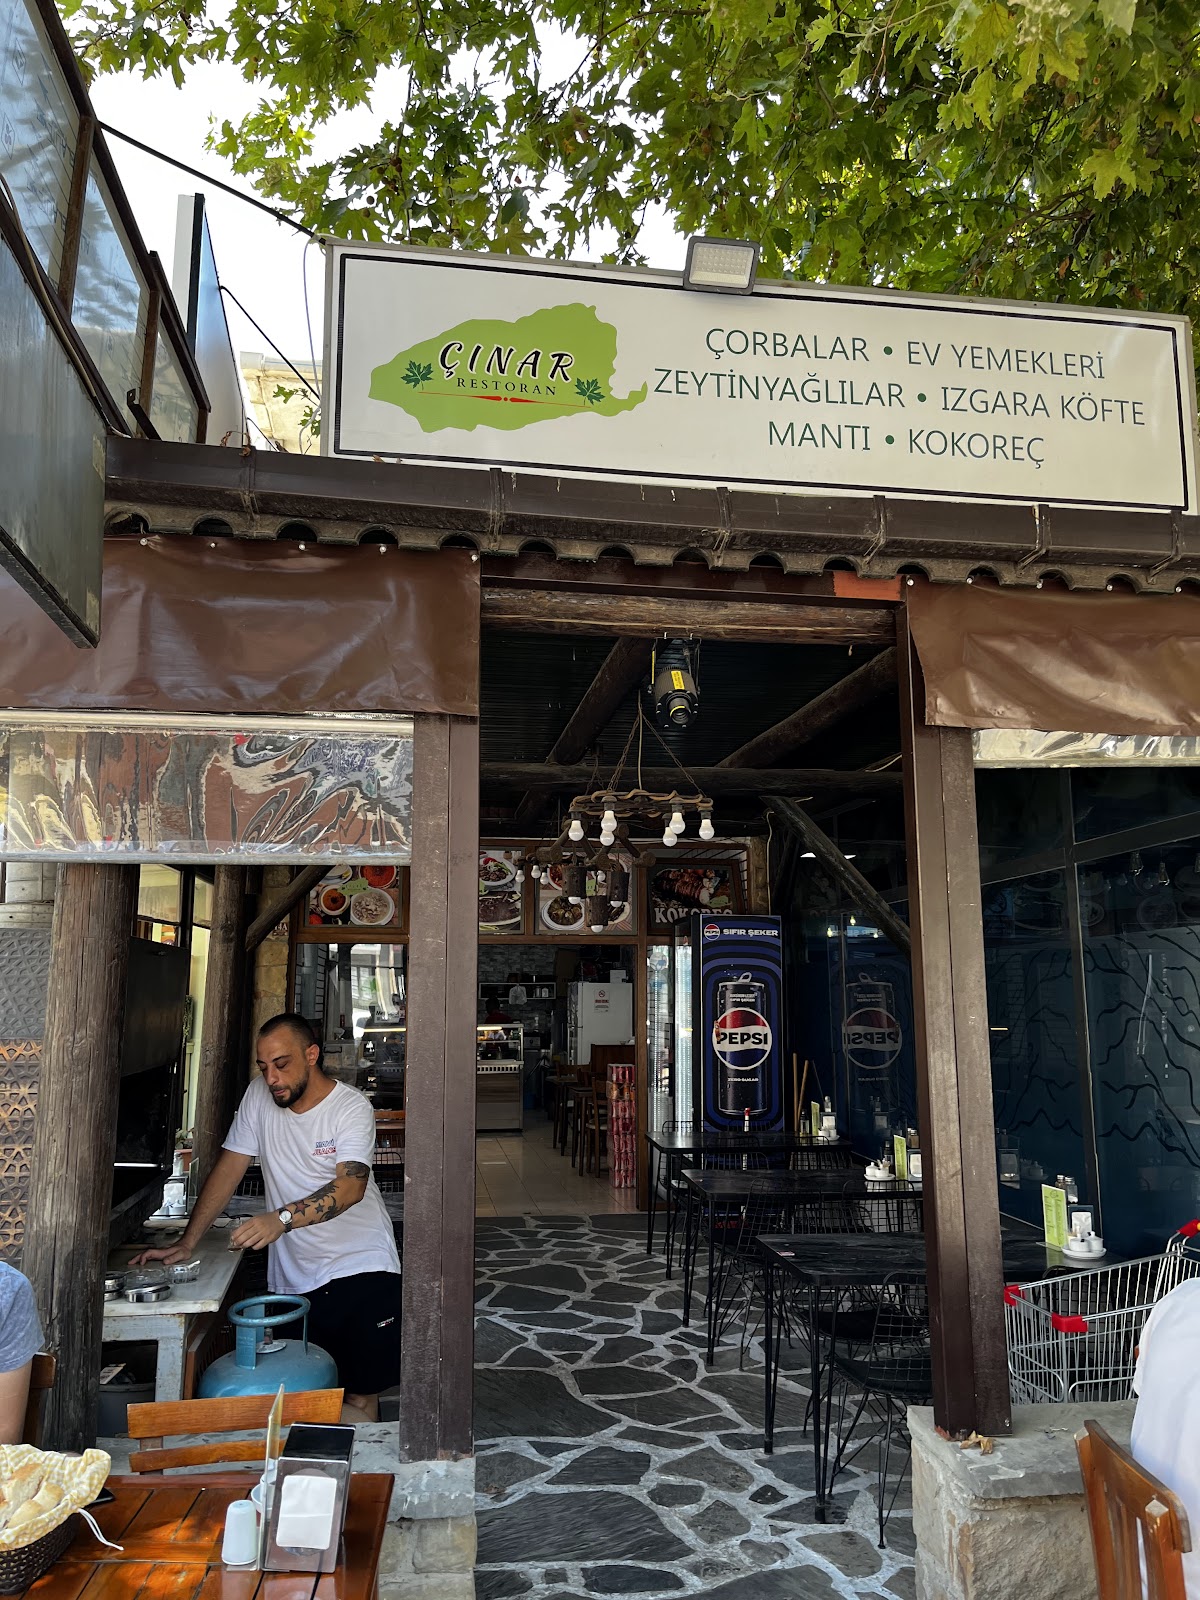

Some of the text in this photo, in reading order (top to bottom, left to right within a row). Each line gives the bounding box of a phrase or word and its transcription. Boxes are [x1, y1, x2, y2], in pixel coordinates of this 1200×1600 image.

[439, 342, 574, 381] ÇINAR
[705, 328, 1104, 380] ÇORBALAR EV YEMEKLERİ
[457, 377, 557, 396] RESTORAN
[654, 368, 1145, 426] ZEYTİNYAĞLILAR IZGARA KÖFTE
[768, 421, 1044, 468] MANTI KOKOREÇ
[748, 929, 778, 937] ŞEKER
[716, 1032, 768, 1045] PEPSI
